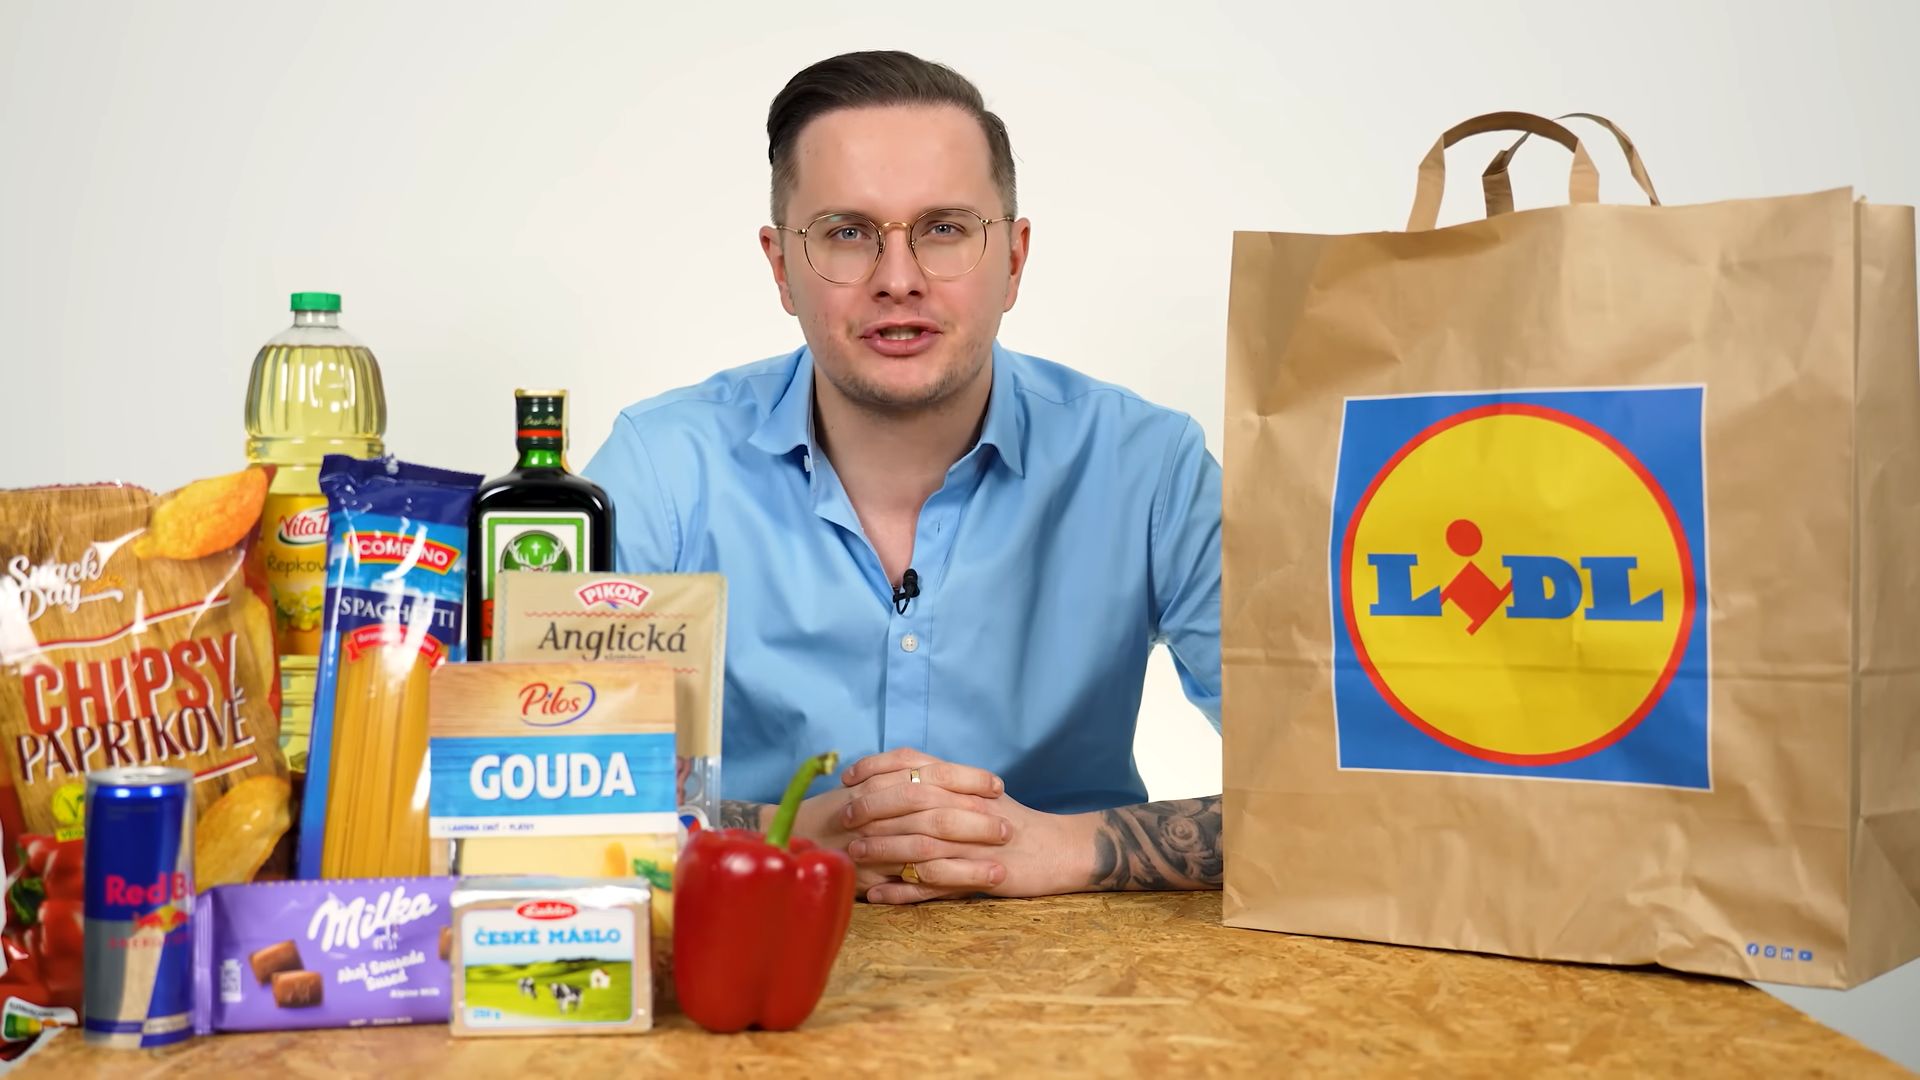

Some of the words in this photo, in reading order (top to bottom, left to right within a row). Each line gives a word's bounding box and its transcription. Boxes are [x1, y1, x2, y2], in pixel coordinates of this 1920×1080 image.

[8, 544, 102, 592] Snack
[583, 584, 640, 604] PIKOK
[537, 621, 687, 662] Anglická
[22, 633, 238, 735] CHIPSY
[519, 682, 581, 717] Pilos
[16, 687, 256, 784] PAPRIKOVÉ
[470, 752, 636, 800] GOUDA
[105, 872, 167, 906] Red
[307, 886, 438, 952] Milka
[474, 927, 540, 945] ČESKÉ
[549, 926, 622, 944] MÁSLO
